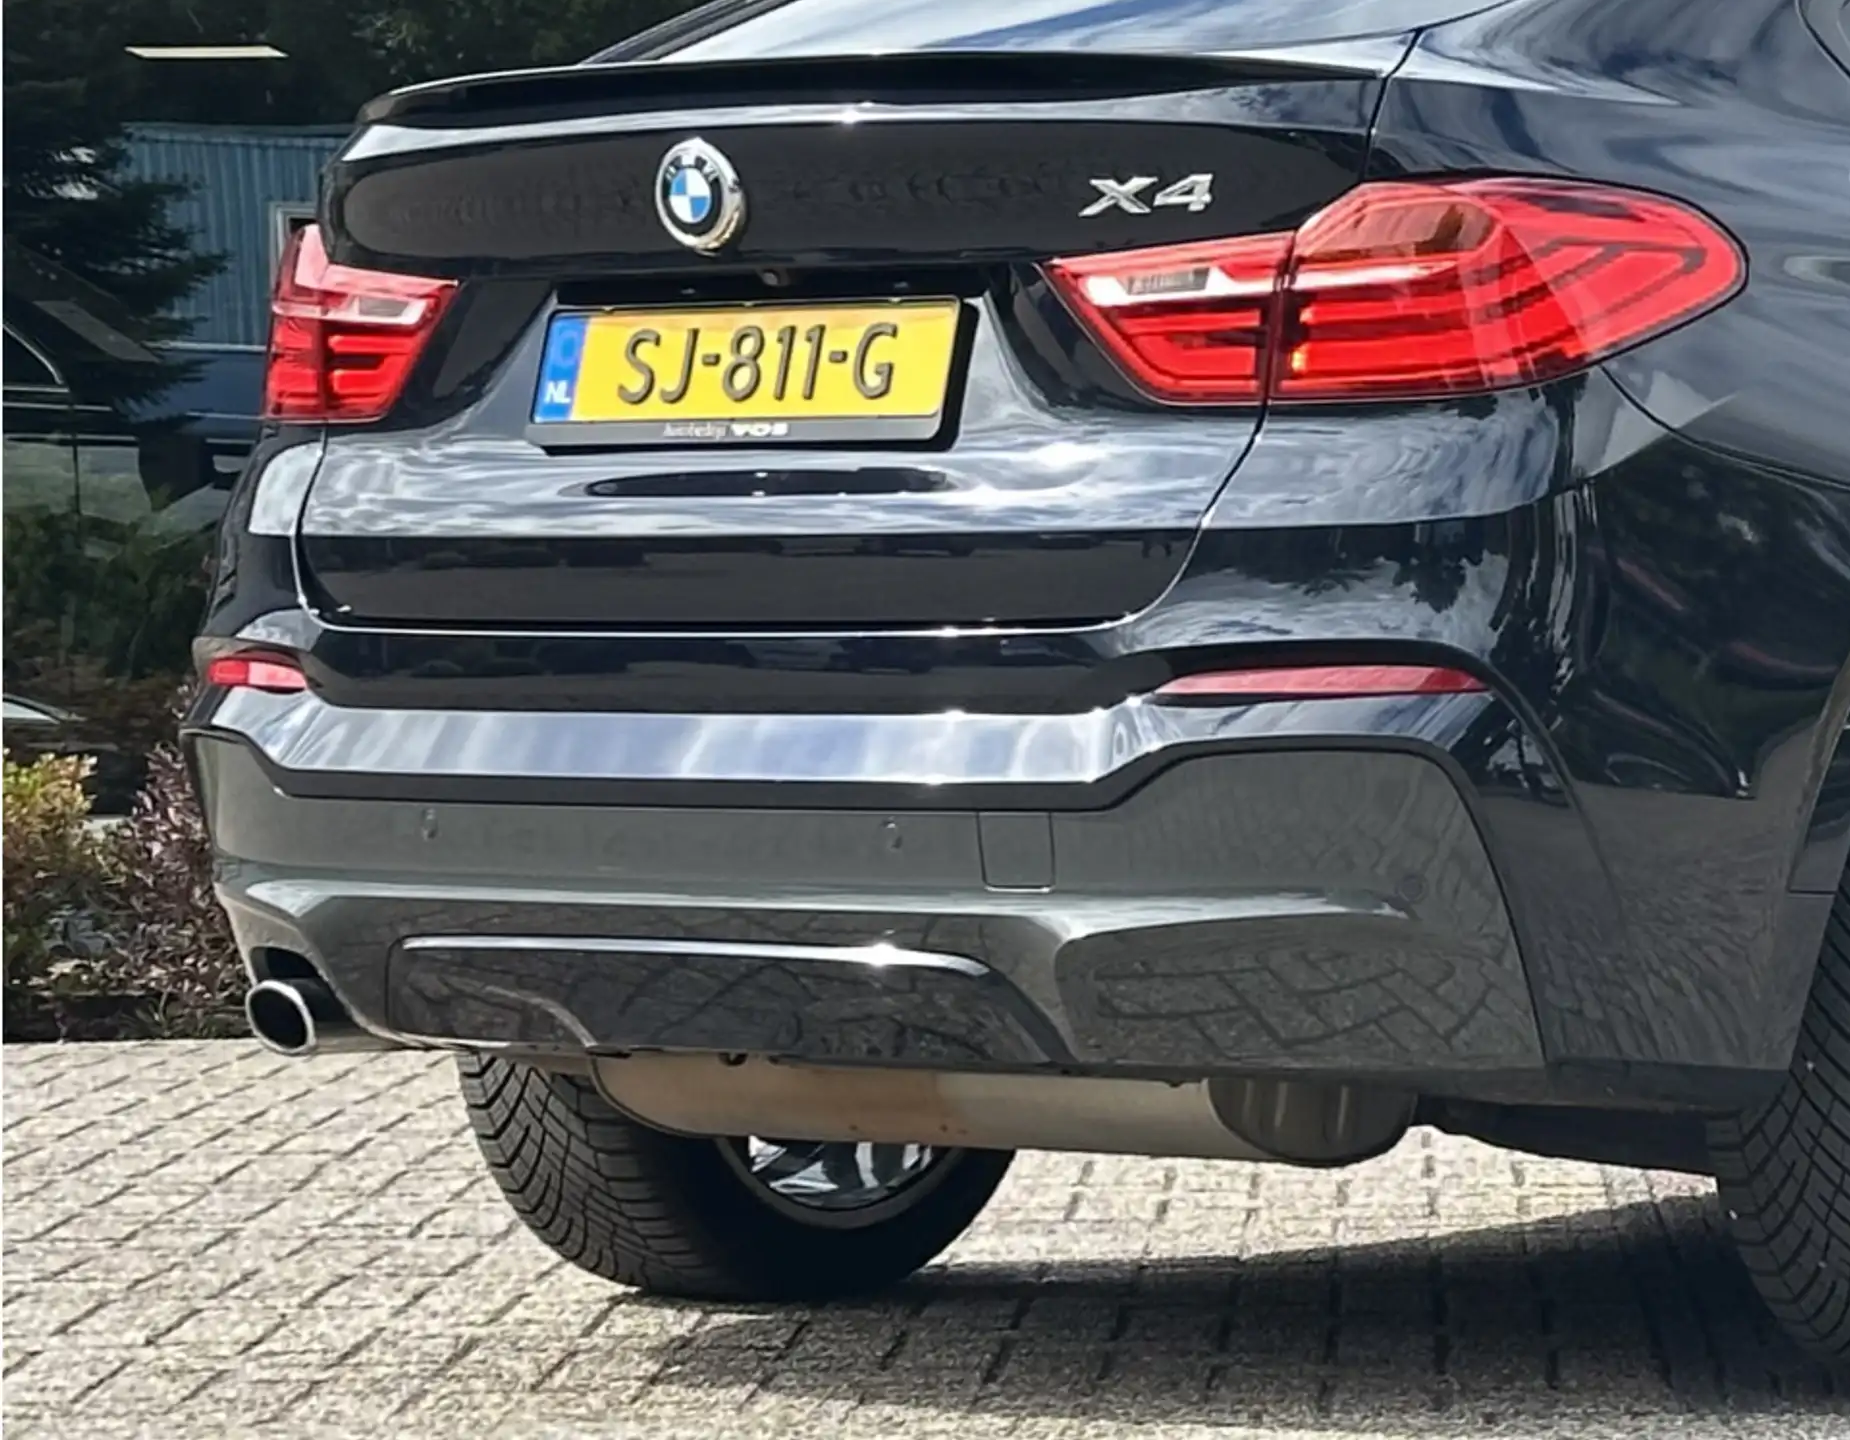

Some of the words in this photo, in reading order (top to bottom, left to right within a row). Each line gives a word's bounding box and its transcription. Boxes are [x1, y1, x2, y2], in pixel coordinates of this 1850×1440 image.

[1078, 173, 1213, 217] X4
[618, 322, 898, 405] SJ-811-G
[545, 381, 571, 404] NL
